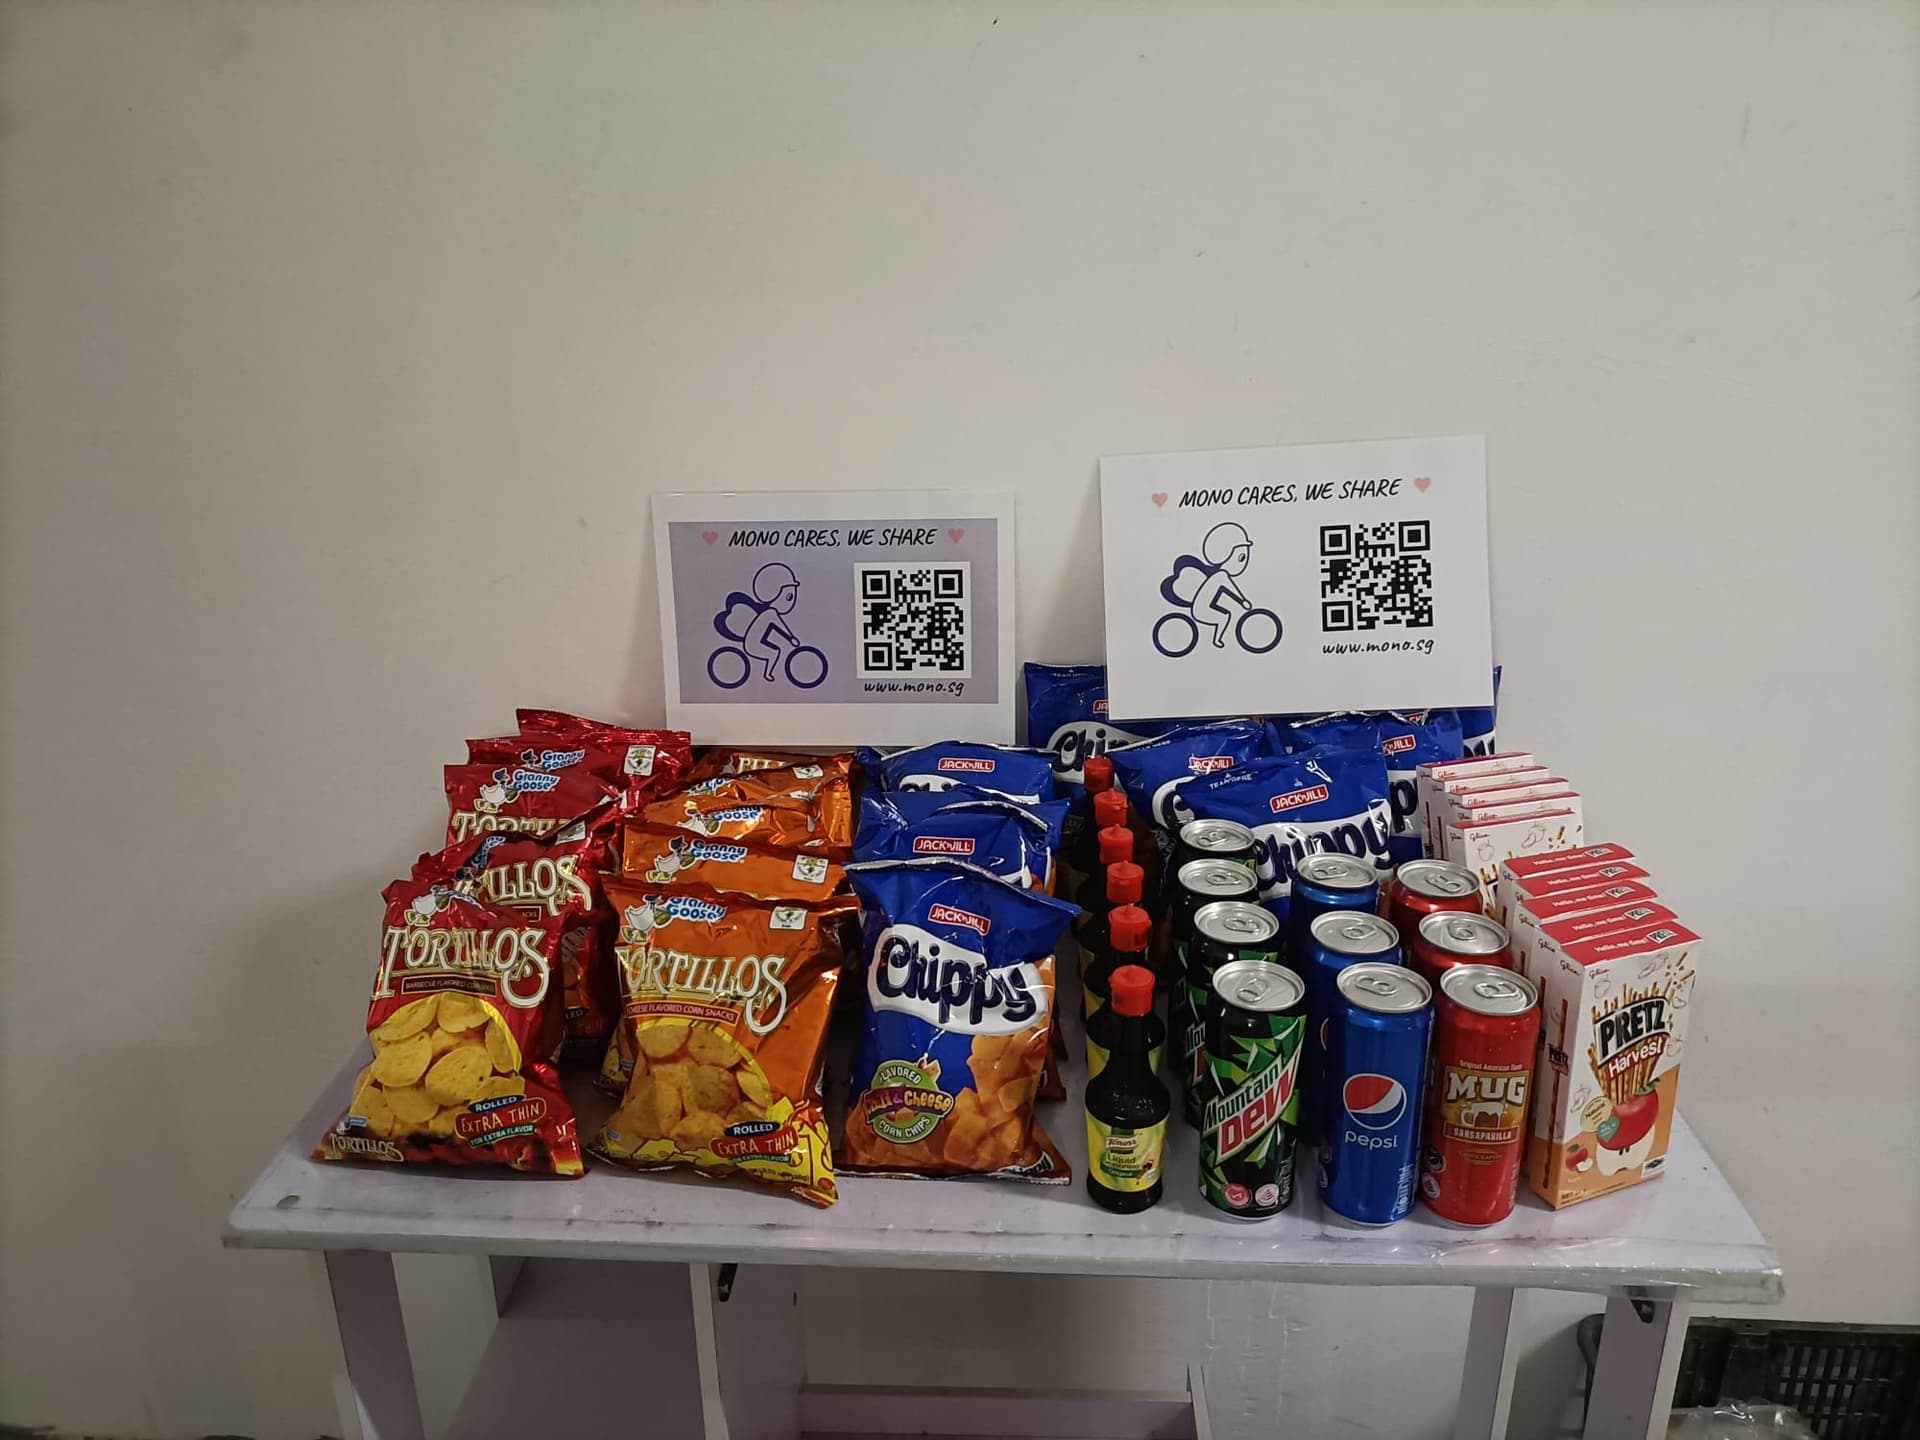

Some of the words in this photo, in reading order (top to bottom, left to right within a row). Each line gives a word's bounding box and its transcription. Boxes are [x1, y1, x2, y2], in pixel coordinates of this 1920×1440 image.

[1178, 488, 1233, 508] MONO
[1237, 484, 1298, 505] CARES,
[1305, 482, 1335, 501] WE
[1338, 478, 1402, 499] SHARE
[729, 530, 780, 547] MONO
[784, 529, 841, 547] CARES,
[847, 529, 875, 546] WE
[879, 528, 937, 546] SHARE
[1322, 639, 1434, 655] www.mono.sg
[864, 681, 965, 695] www.mono.sg
[514, 771, 558, 784] Granny
[691, 841, 746, 856] Granny
[1560, 960, 1580, 976] Glico
[1588, 966, 1611, 980] Glico
[876, 935, 1037, 1026] Chippy
[683, 1005, 704, 1016] CORN
[705, 1008, 735, 1021] SNACKS
[1599, 999, 1666, 1058] PRETZ
[1608, 1036, 1664, 1079] Harvest
[1203, 1063, 1279, 1129] Mountain
[1447, 1072, 1526, 1105] MUG
[475, 1096, 518, 1112] ROLLED
[903, 1090, 952, 1112] Cheese
[461, 1111, 503, 1133] EXTRA
[508, 1102, 540, 1123] THIN
[879, 1120, 903, 1137] CORN
[904, 1116, 931, 1138] CHIPS
[484, 1130, 506, 1141] EXTRA
[506, 1124, 534, 1136] FLAVOR
[733, 1123, 774, 1135] ROLLED
[1453, 1127, 1512, 1140] SARSAPARILLA
[330, 1133, 404, 1162] TORTILLOS
[717, 1138, 760, 1155] EXTRA
[765, 1131, 795, 1152] THIN
[1344, 1130, 1398, 1150] pepsi
[1107, 1153, 1136, 1164] Liquid
